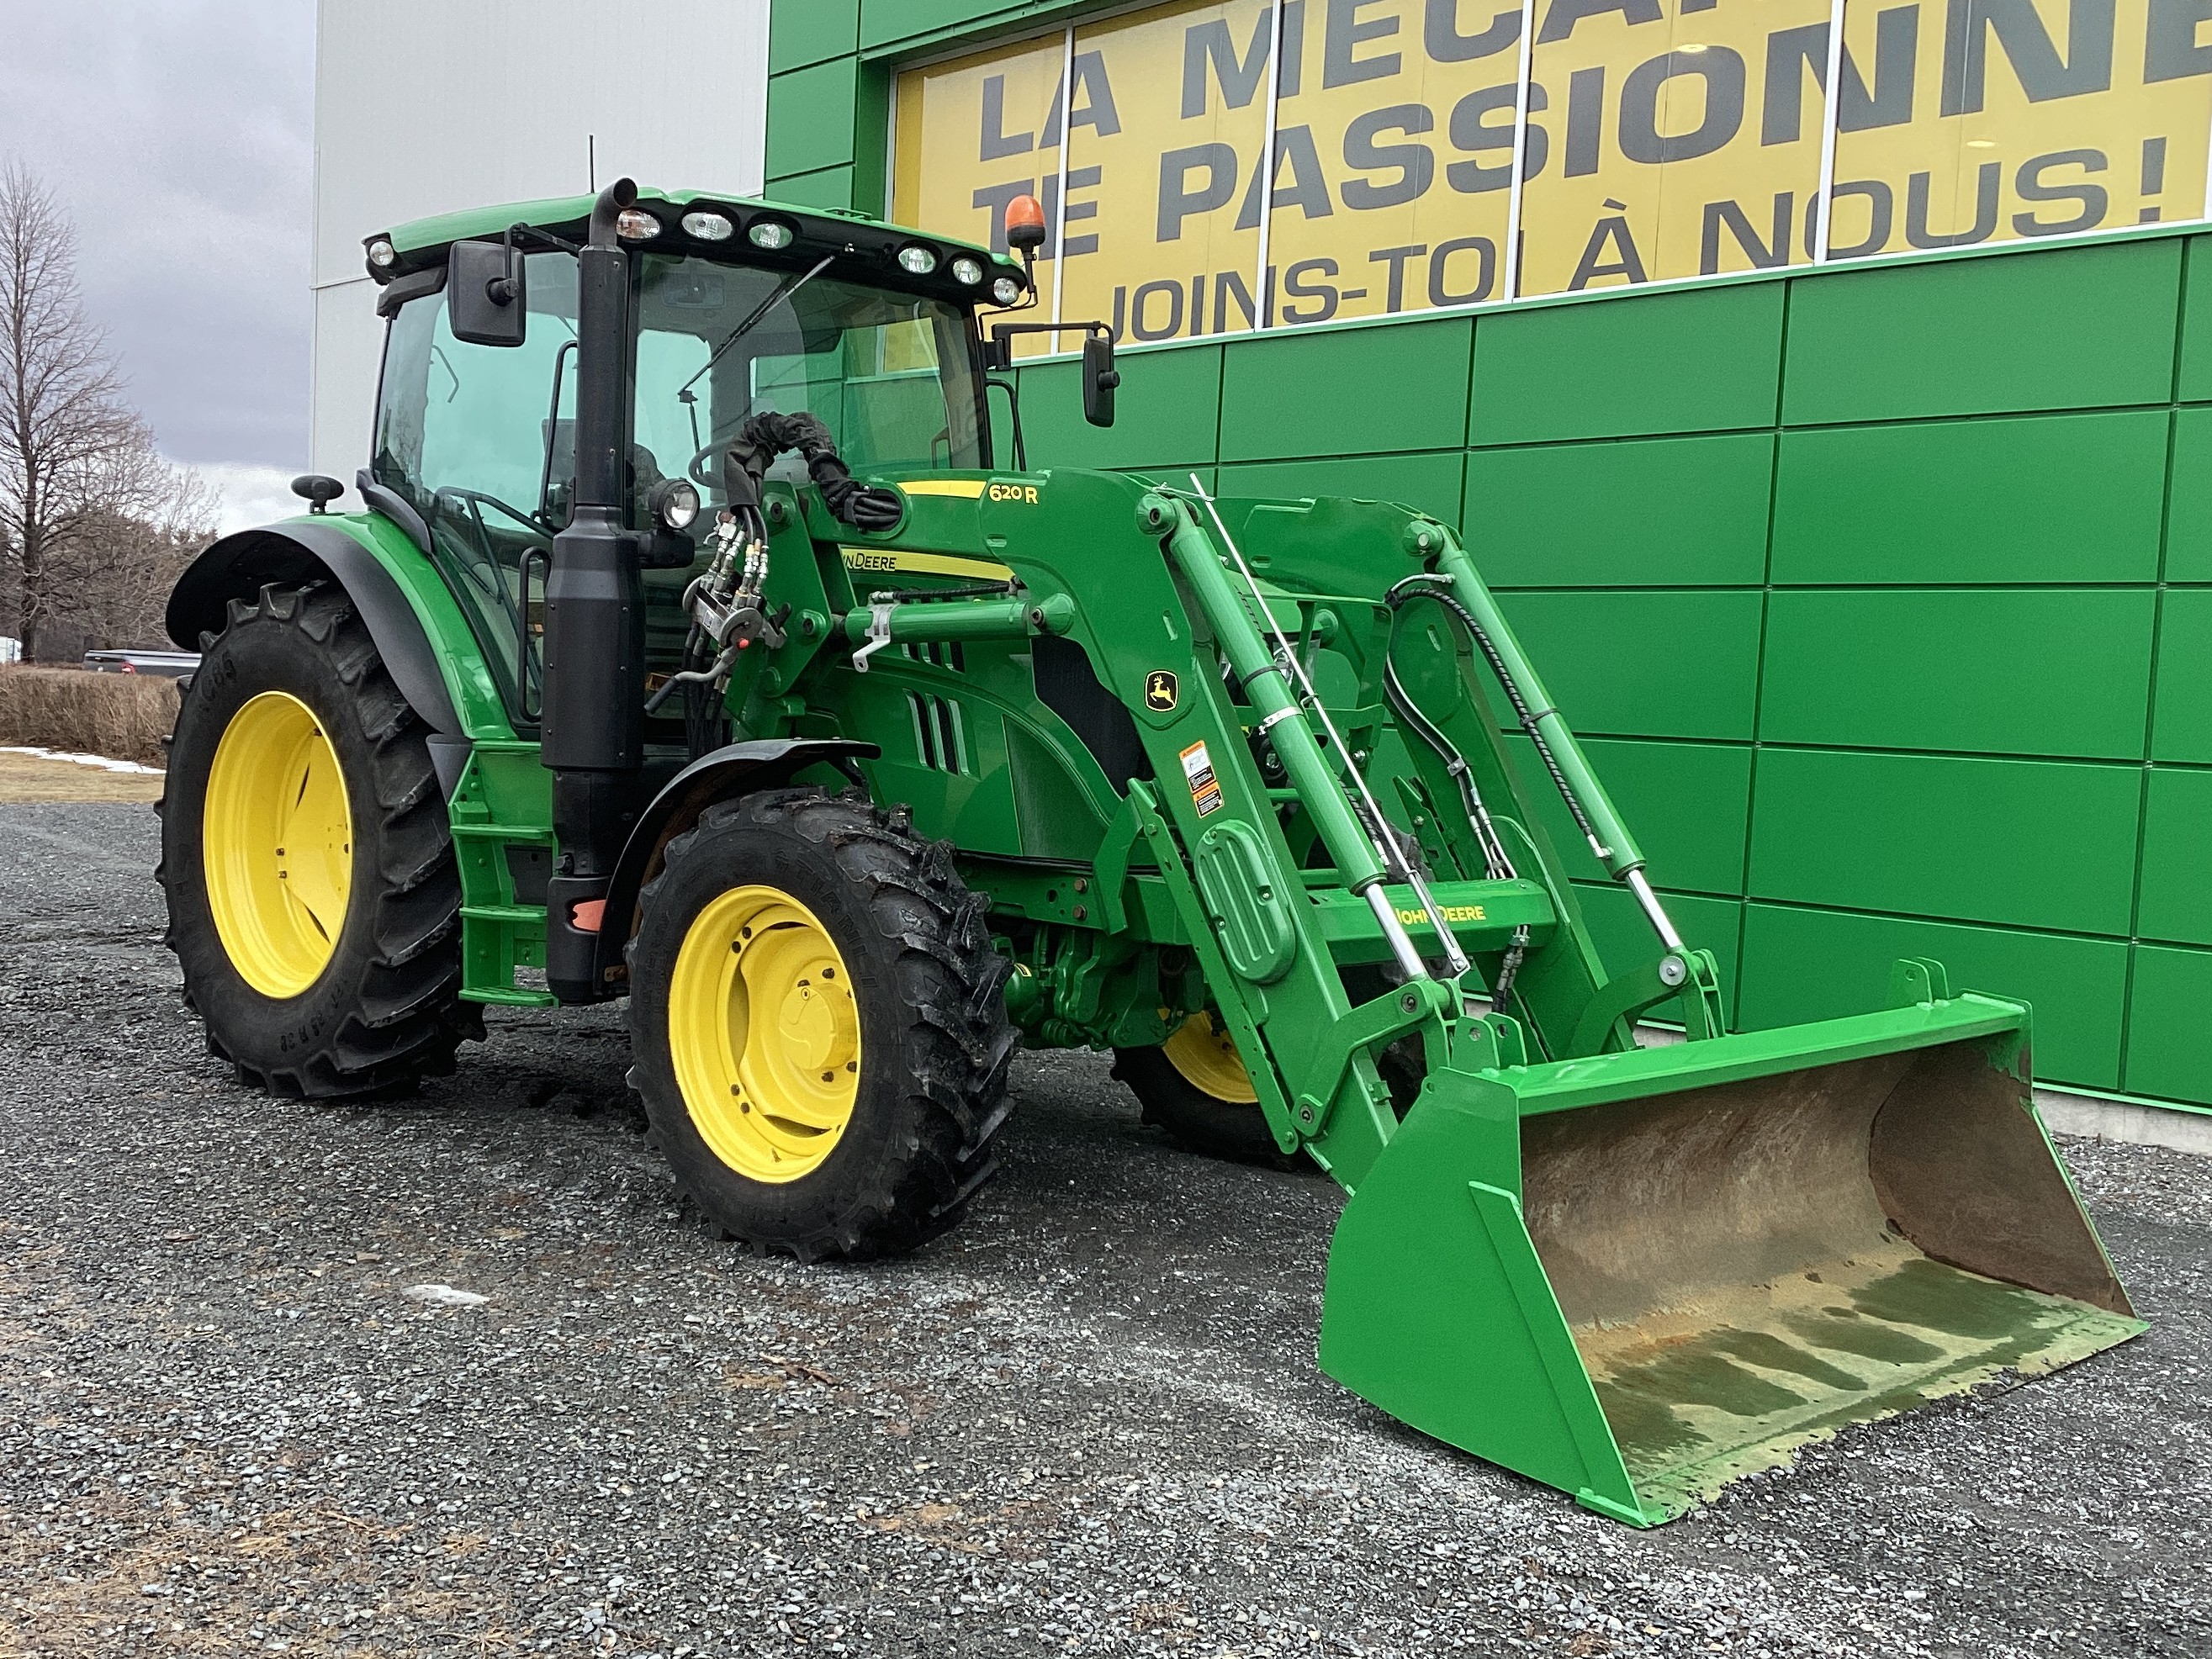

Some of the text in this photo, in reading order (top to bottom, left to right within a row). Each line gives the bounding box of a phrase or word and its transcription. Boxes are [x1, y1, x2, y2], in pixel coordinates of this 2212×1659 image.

[979, 0, 1717, 161] LA MEC
[972, 165, 1102, 261] TE
[1567, 198, 1648, 291] À
[855, 552, 897, 569] DEERE
